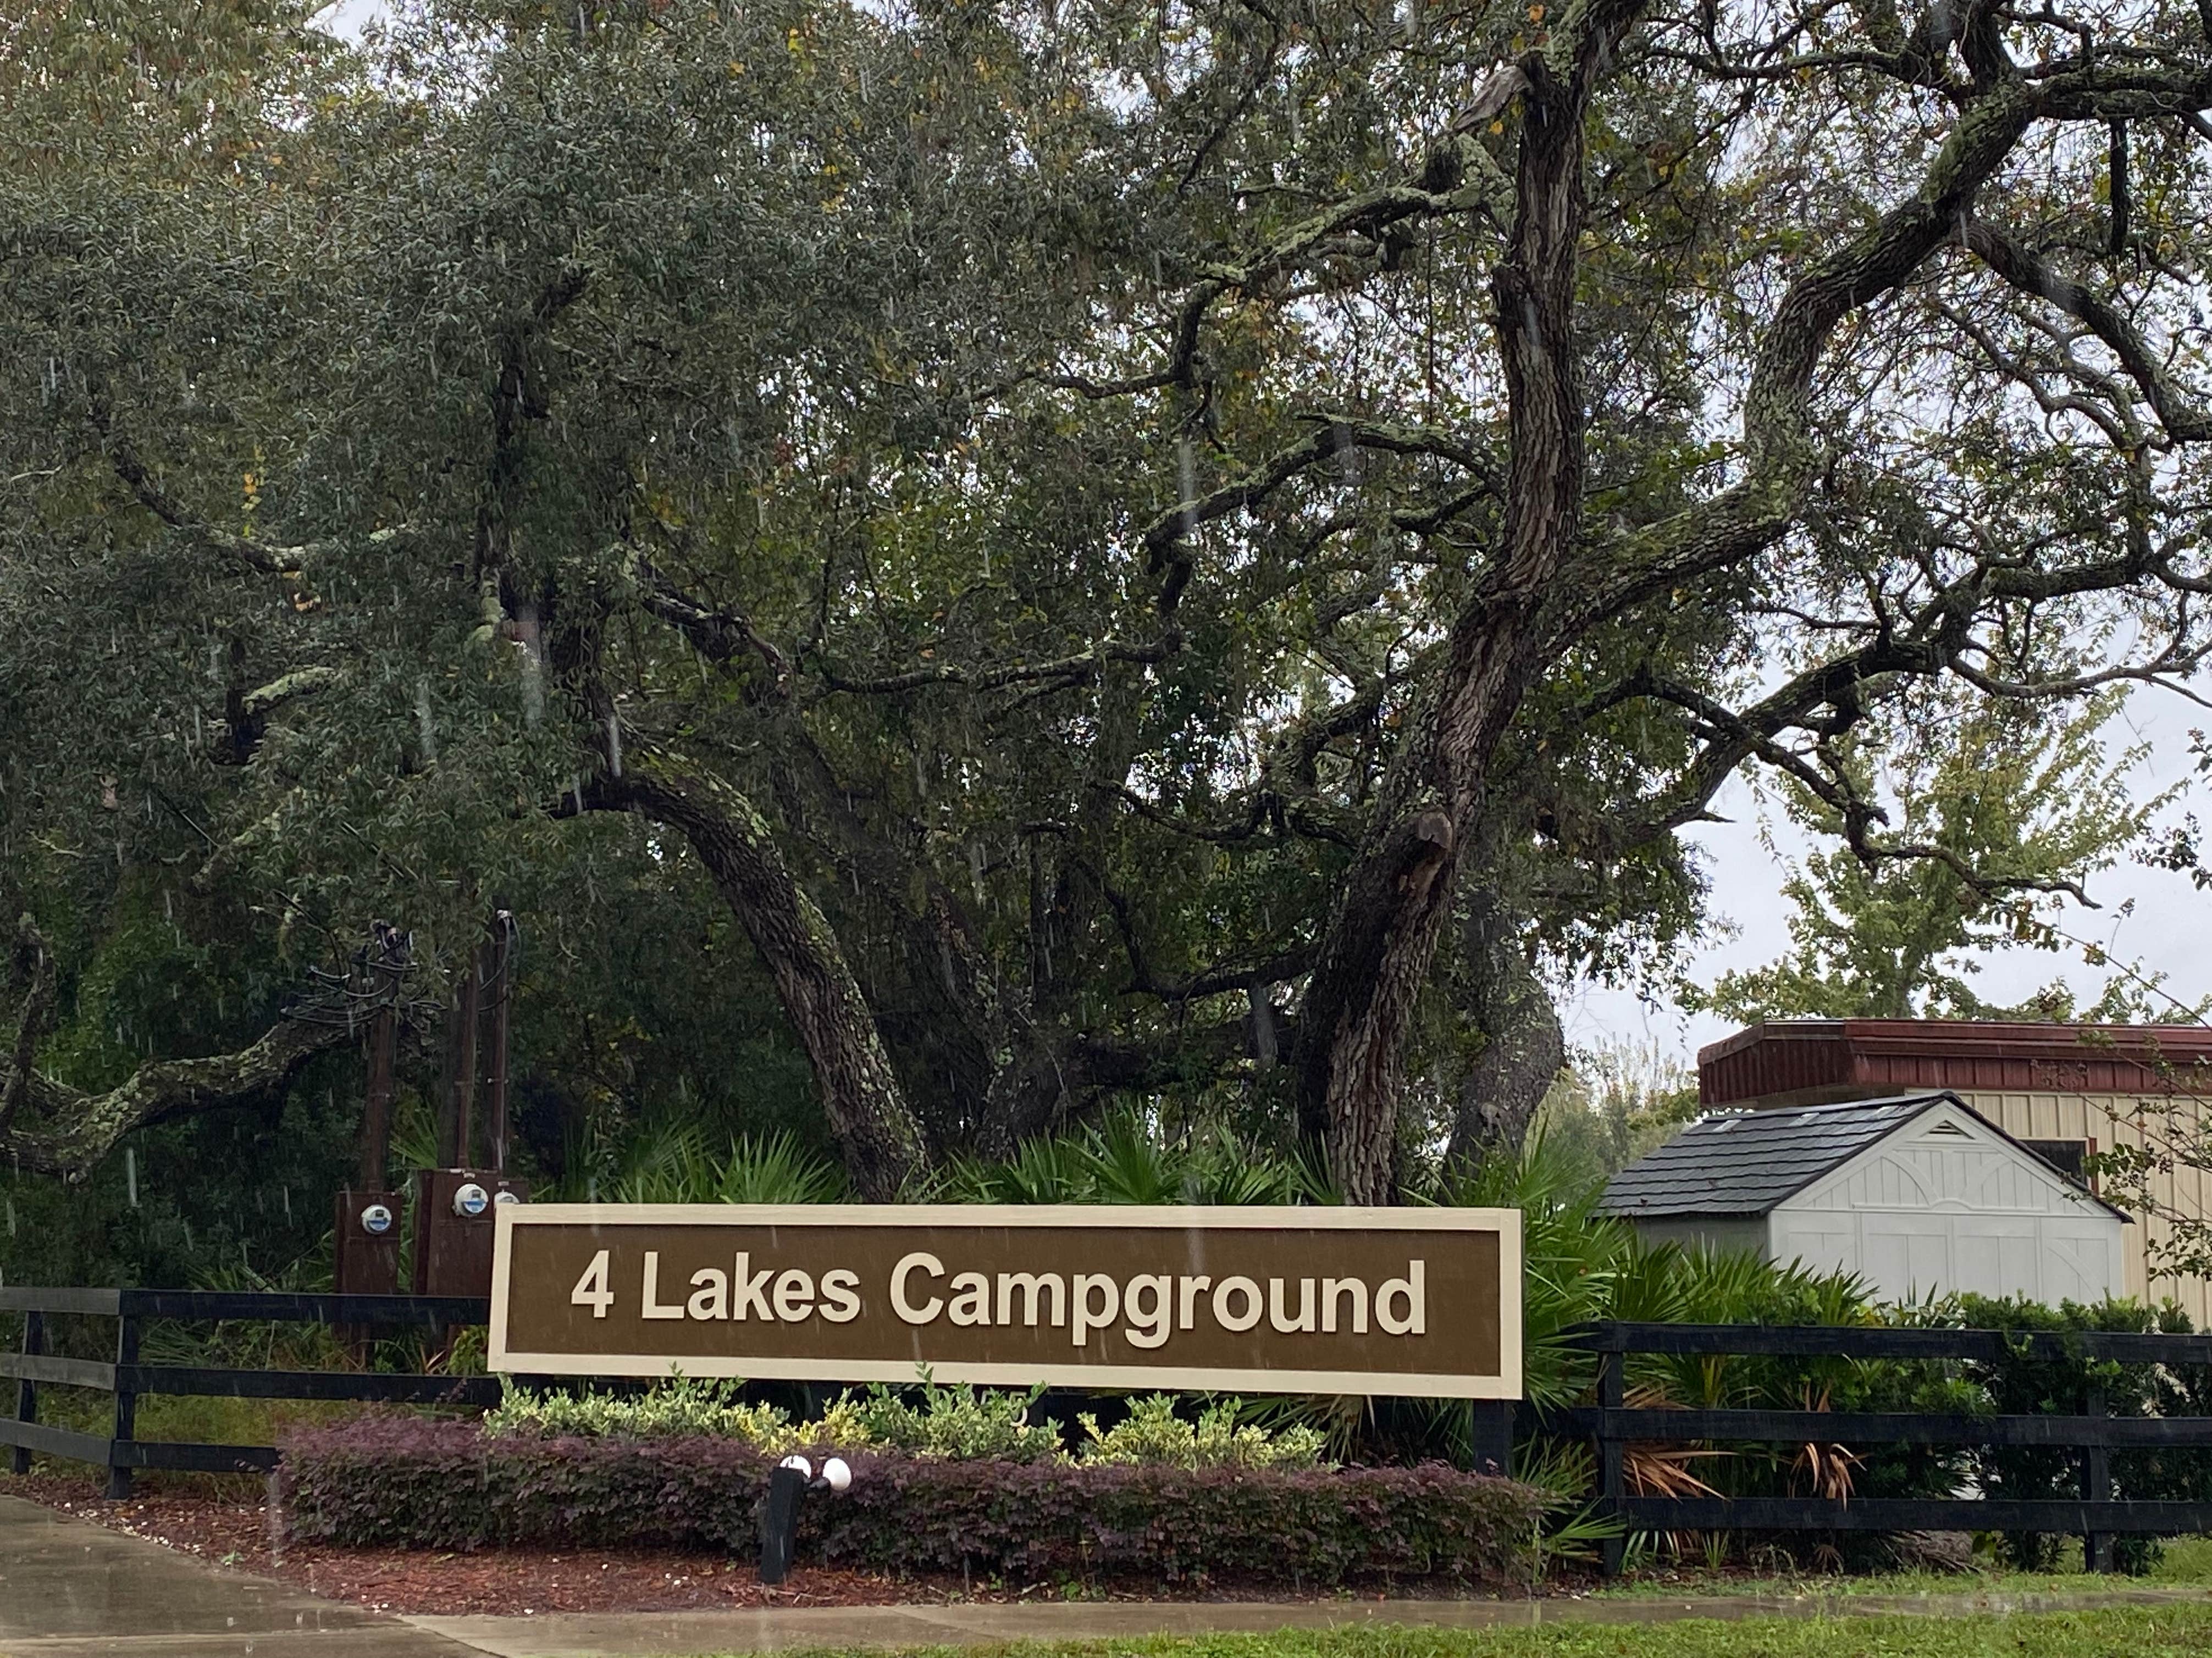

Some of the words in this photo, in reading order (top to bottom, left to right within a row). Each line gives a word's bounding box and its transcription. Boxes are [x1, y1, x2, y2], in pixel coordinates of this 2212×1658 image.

[571, 1250, 615, 1318] 4
[642, 1251, 861, 1322] Lakes
[890, 1252, 1427, 1349] Campground
